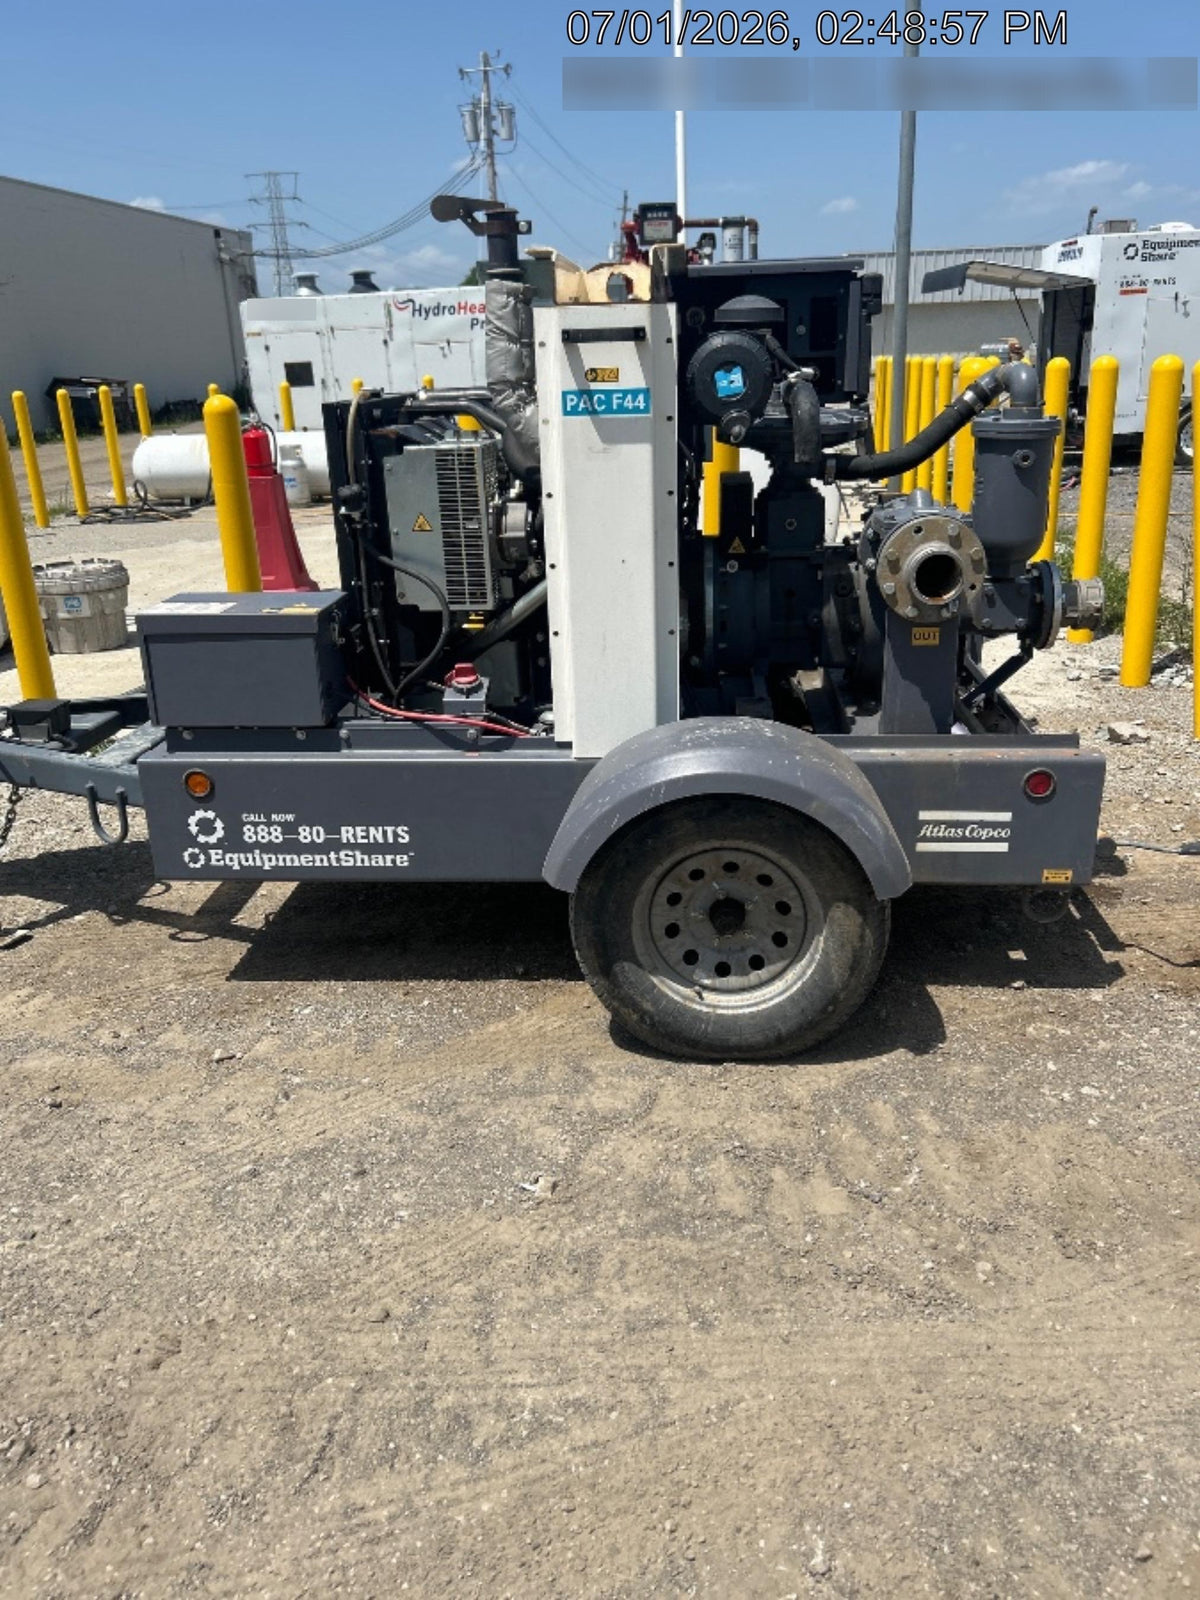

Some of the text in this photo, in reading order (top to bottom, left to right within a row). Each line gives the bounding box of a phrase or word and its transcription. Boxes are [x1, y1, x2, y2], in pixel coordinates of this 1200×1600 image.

[566, 392, 646, 412] PAC F44
[913, 630, 938, 641] OUT
[241, 813, 296, 822] CALL NOW
[242, 824, 410, 844] 888-80-RENTS
[916, 823, 1011, 840] Atlas Copco
[207, 848, 411, 870] EquipmentShare
